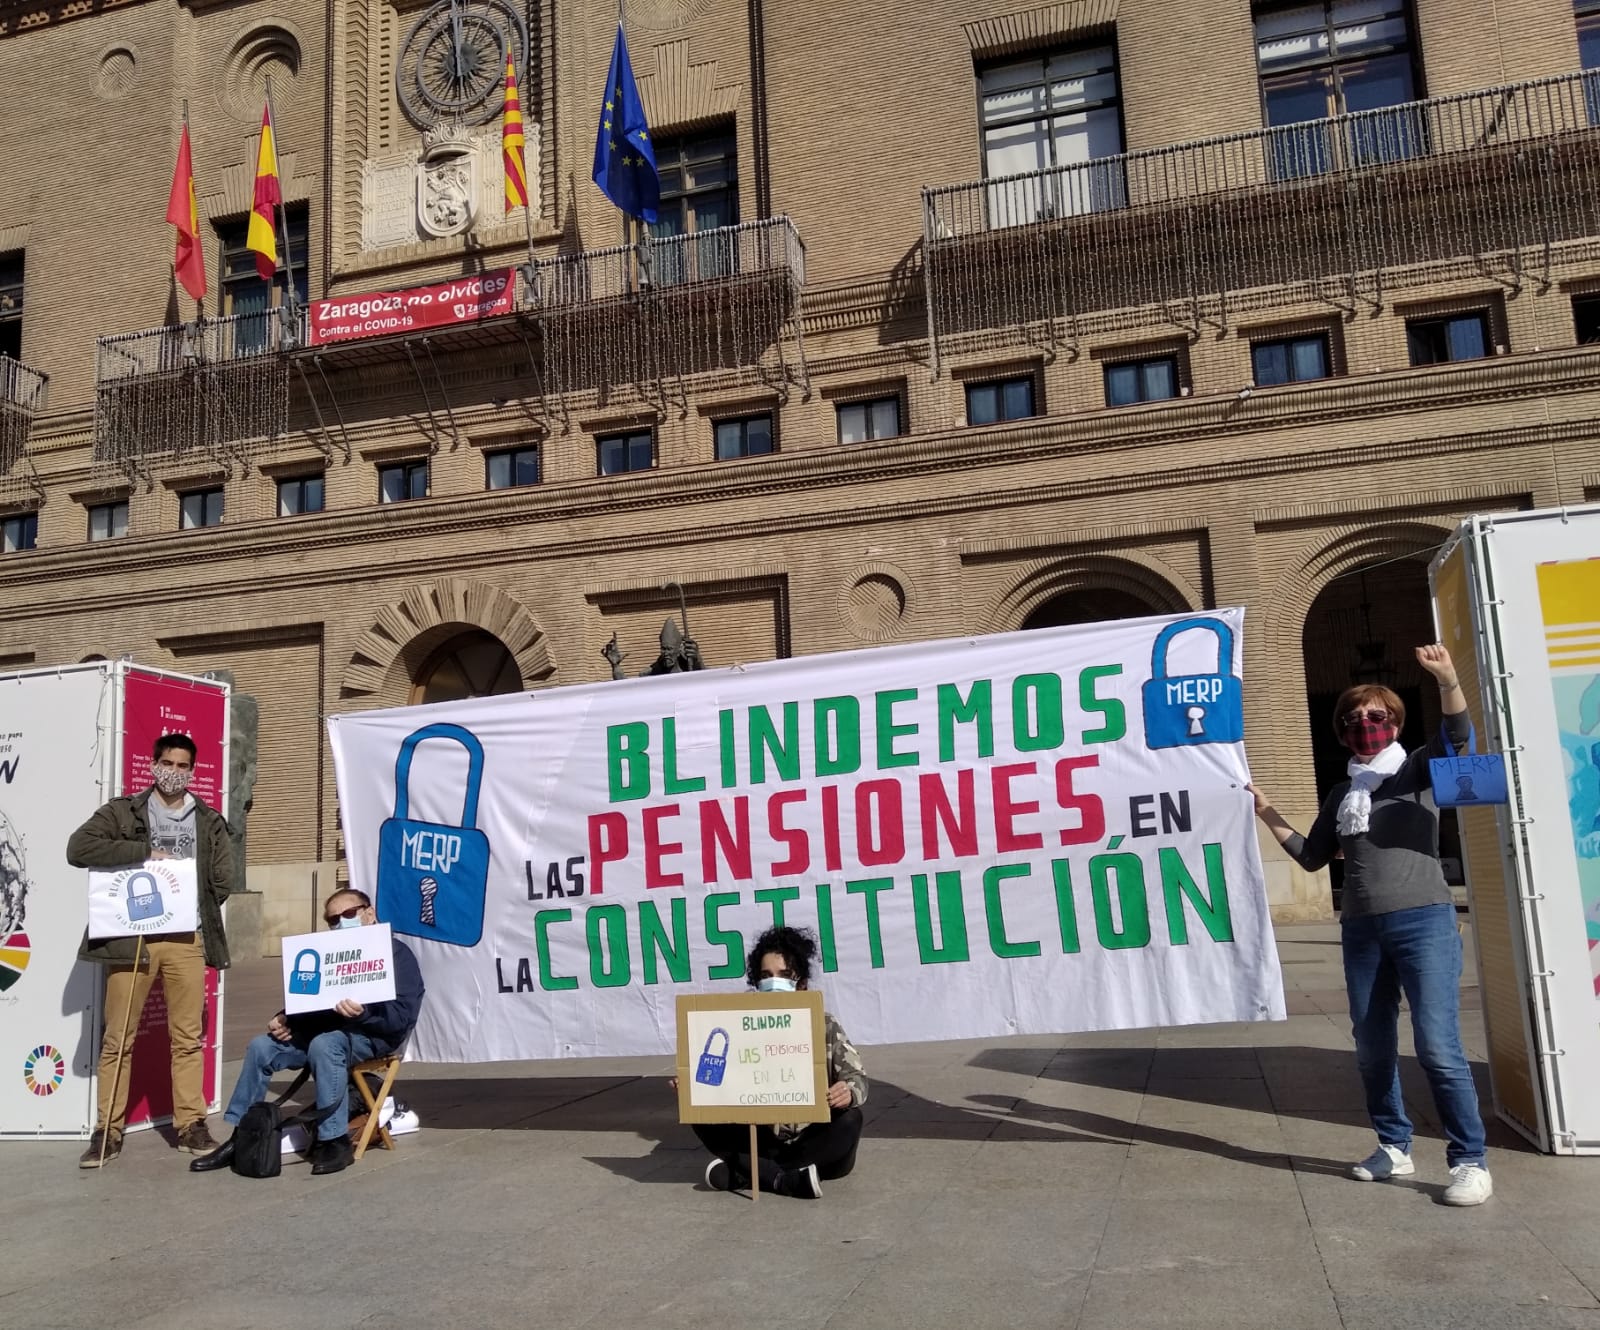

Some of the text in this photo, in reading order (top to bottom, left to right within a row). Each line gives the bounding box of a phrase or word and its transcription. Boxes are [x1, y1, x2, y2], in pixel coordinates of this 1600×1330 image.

[319, 275, 506, 321] Zaragoza, no olvides
[466, 297, 507, 315] Zaragoza
[319, 316, 413, 338] Contra el COVID-19
[1166, 678, 1223, 706] MERP
[606, 663, 1126, 803] BLINDEMOS
[1432, 755, 1499, 776] MERP
[525, 753, 1192, 901] LAS PENSIONES EN
[401, 828, 461, 874] MERP
[495, 834, 1235, 994] LA CONSTITUCIÓN
[324, 949, 362, 965] BLINDAR
[336, 959, 385, 977] PENSIONES
[742, 1013, 792, 1031] BLINDAR
[738, 1044, 809, 1064] LAS PENSIONES
[753, 1067, 795, 1085] EN LA
